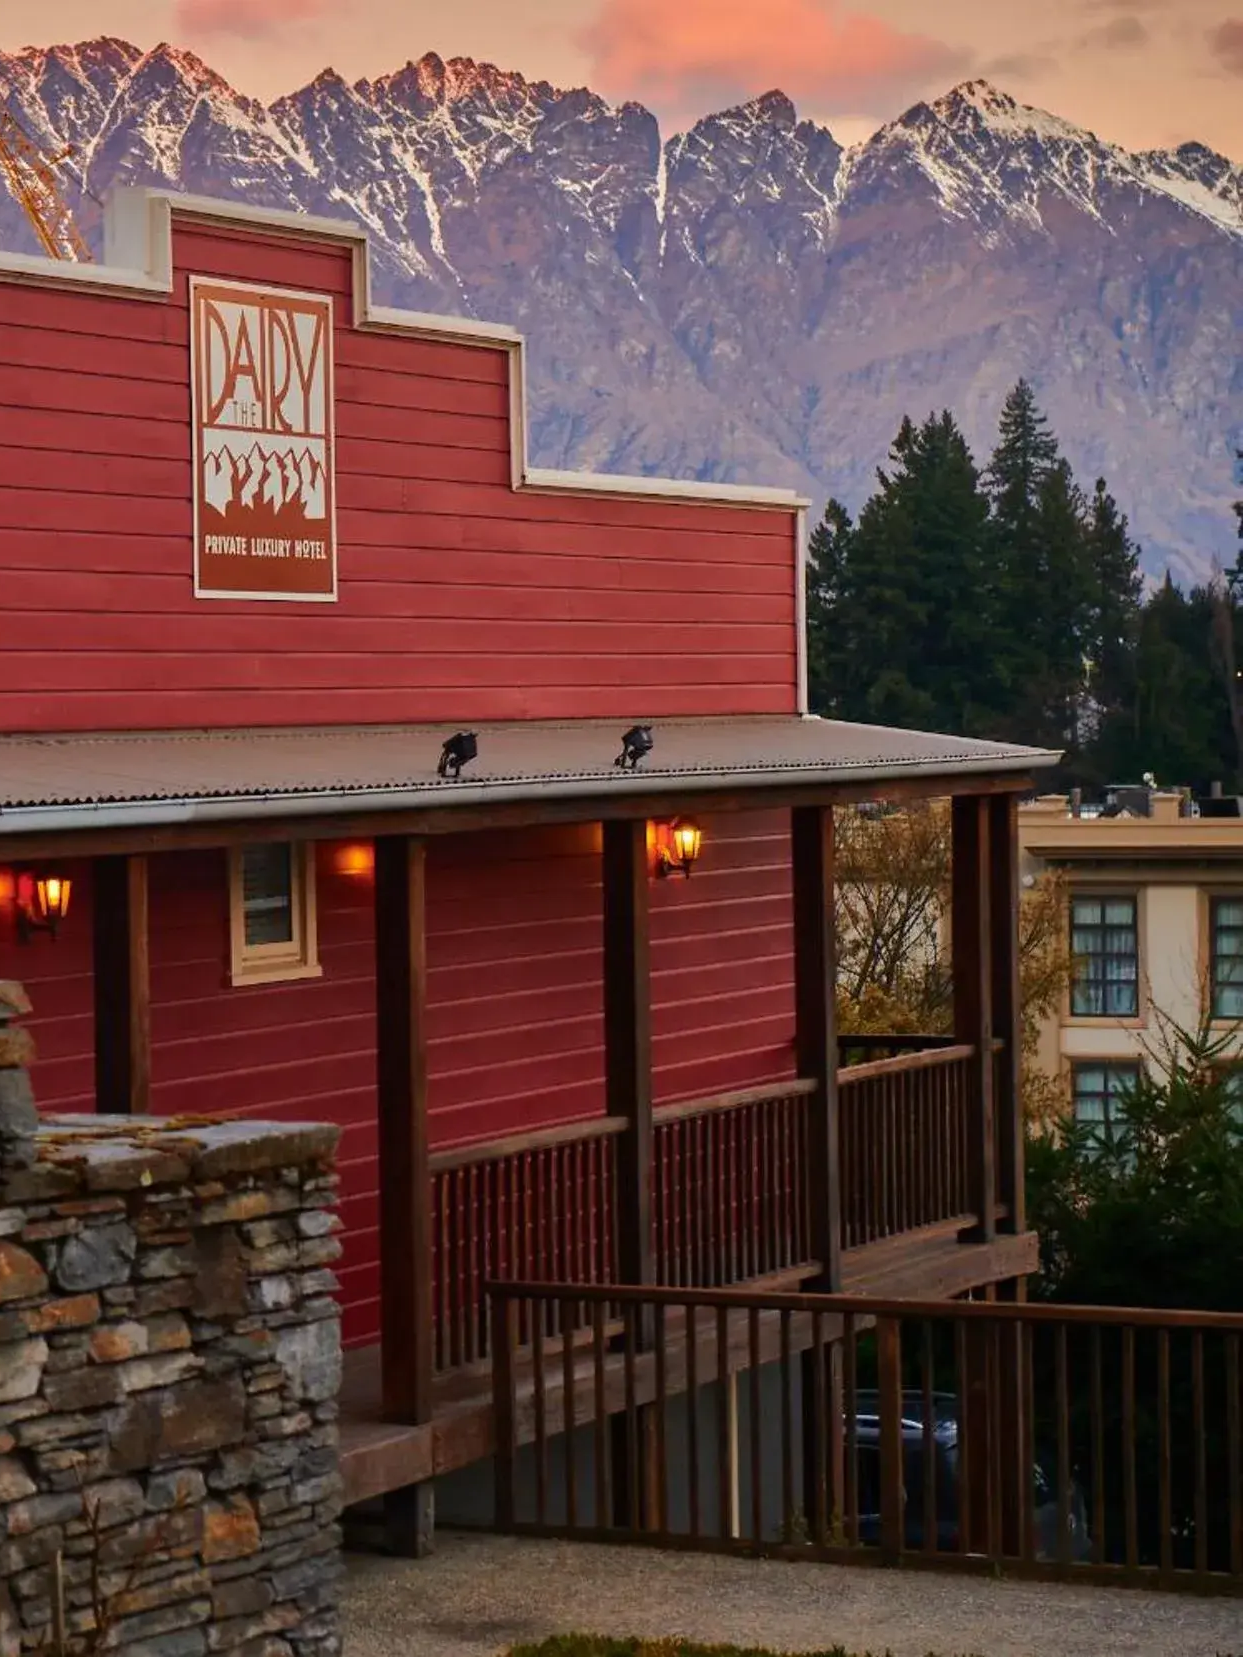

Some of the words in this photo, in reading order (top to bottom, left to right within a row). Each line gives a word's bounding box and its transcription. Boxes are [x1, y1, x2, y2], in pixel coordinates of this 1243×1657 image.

[204, 299, 324, 433] DAIRY
[232, 400, 257, 427] THE
[204, 535, 247, 556] PRIVATE
[251, 537, 291, 558] LUXURY
[294, 539, 327, 560] HOTEL
